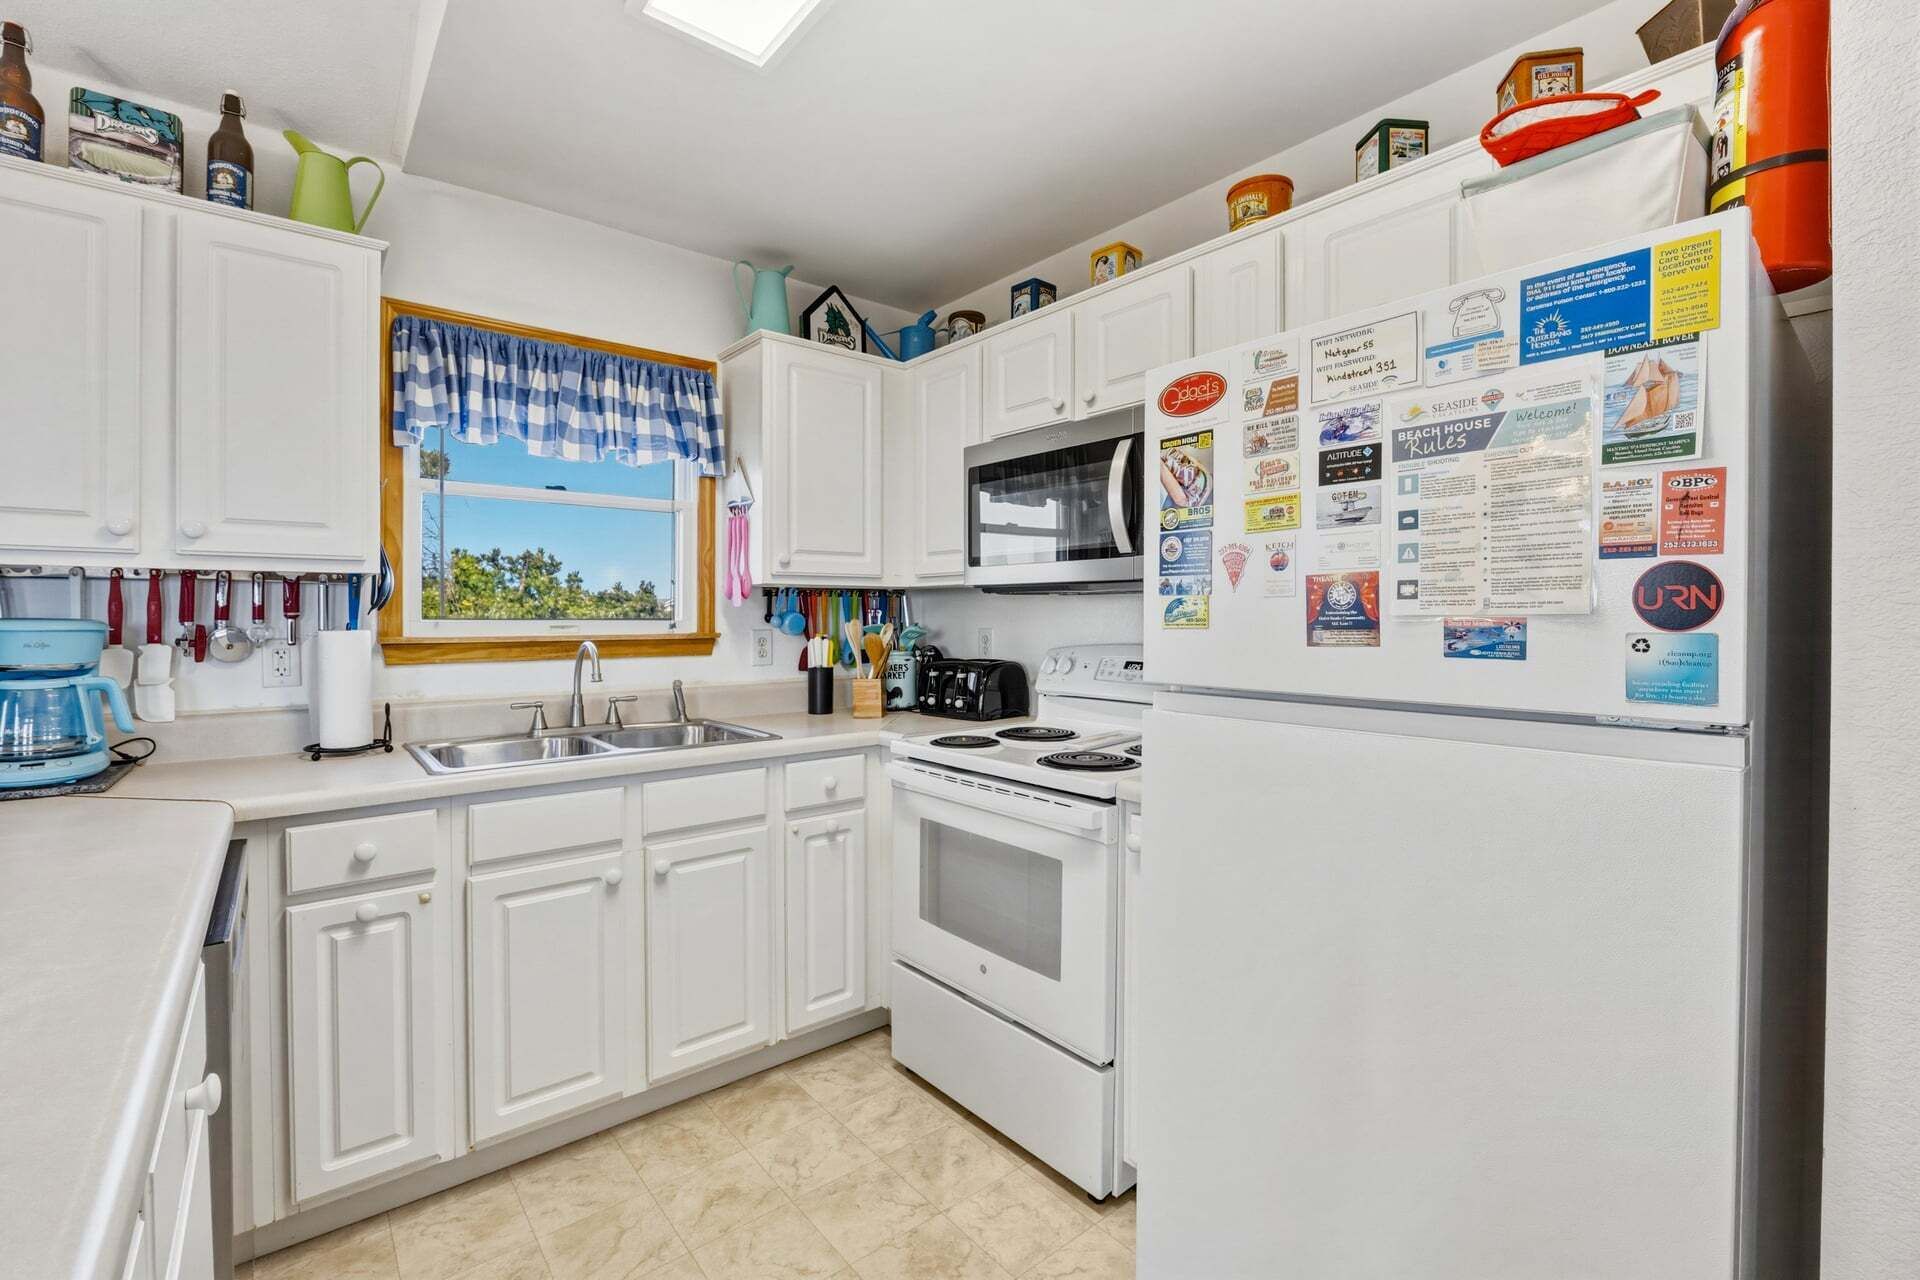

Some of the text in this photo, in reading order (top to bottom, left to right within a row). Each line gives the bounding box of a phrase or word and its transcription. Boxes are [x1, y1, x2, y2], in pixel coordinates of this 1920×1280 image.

[1658, 247, 1713, 265] Care Center
[1660, 239, 1713, 257] Two Urgent
[1658, 254, 1713, 273] Locations to
[1661, 268, 1688, 278] Serve
[1315, 338, 1333, 348] WIFI
[1316, 365, 1333, 374] WIFI
[1431, 397, 1479, 413] SEASIDE
[1516, 402, 1577, 422] Welcome!
[1398, 417, 1492, 441] BEACH HOUSE
[1326, 448, 1363, 461] ALTITUDE
[1404, 433, 1467, 459] Rules
[1637, 584, 1717, 611] URN
